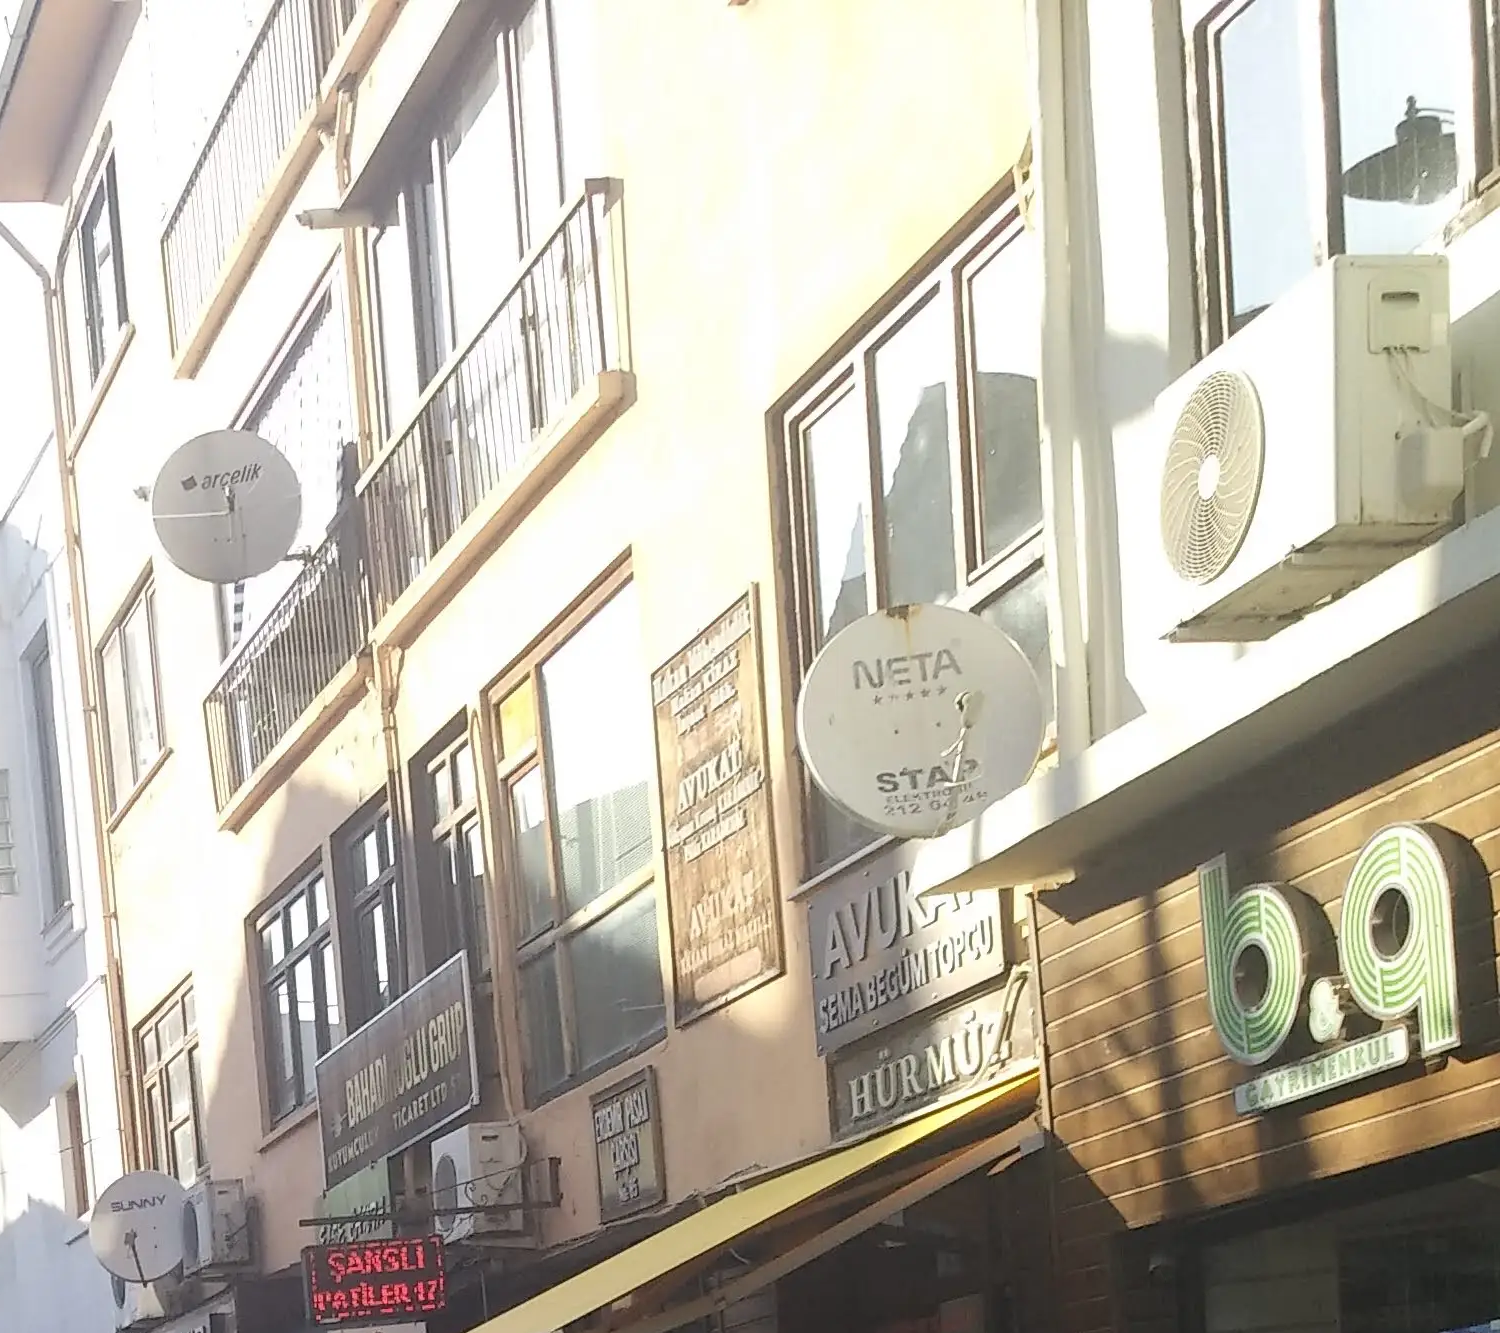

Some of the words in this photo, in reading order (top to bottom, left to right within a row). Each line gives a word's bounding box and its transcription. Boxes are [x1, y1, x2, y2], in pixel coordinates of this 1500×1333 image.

[853, 649, 962, 689] NETA
[819, 979, 866, 1035] SEMA
[927, 915, 995, 980] TOPÇU
[429, 1000, 465, 1073] GRUP
[111, 1194, 166, 1213] SUNNY
